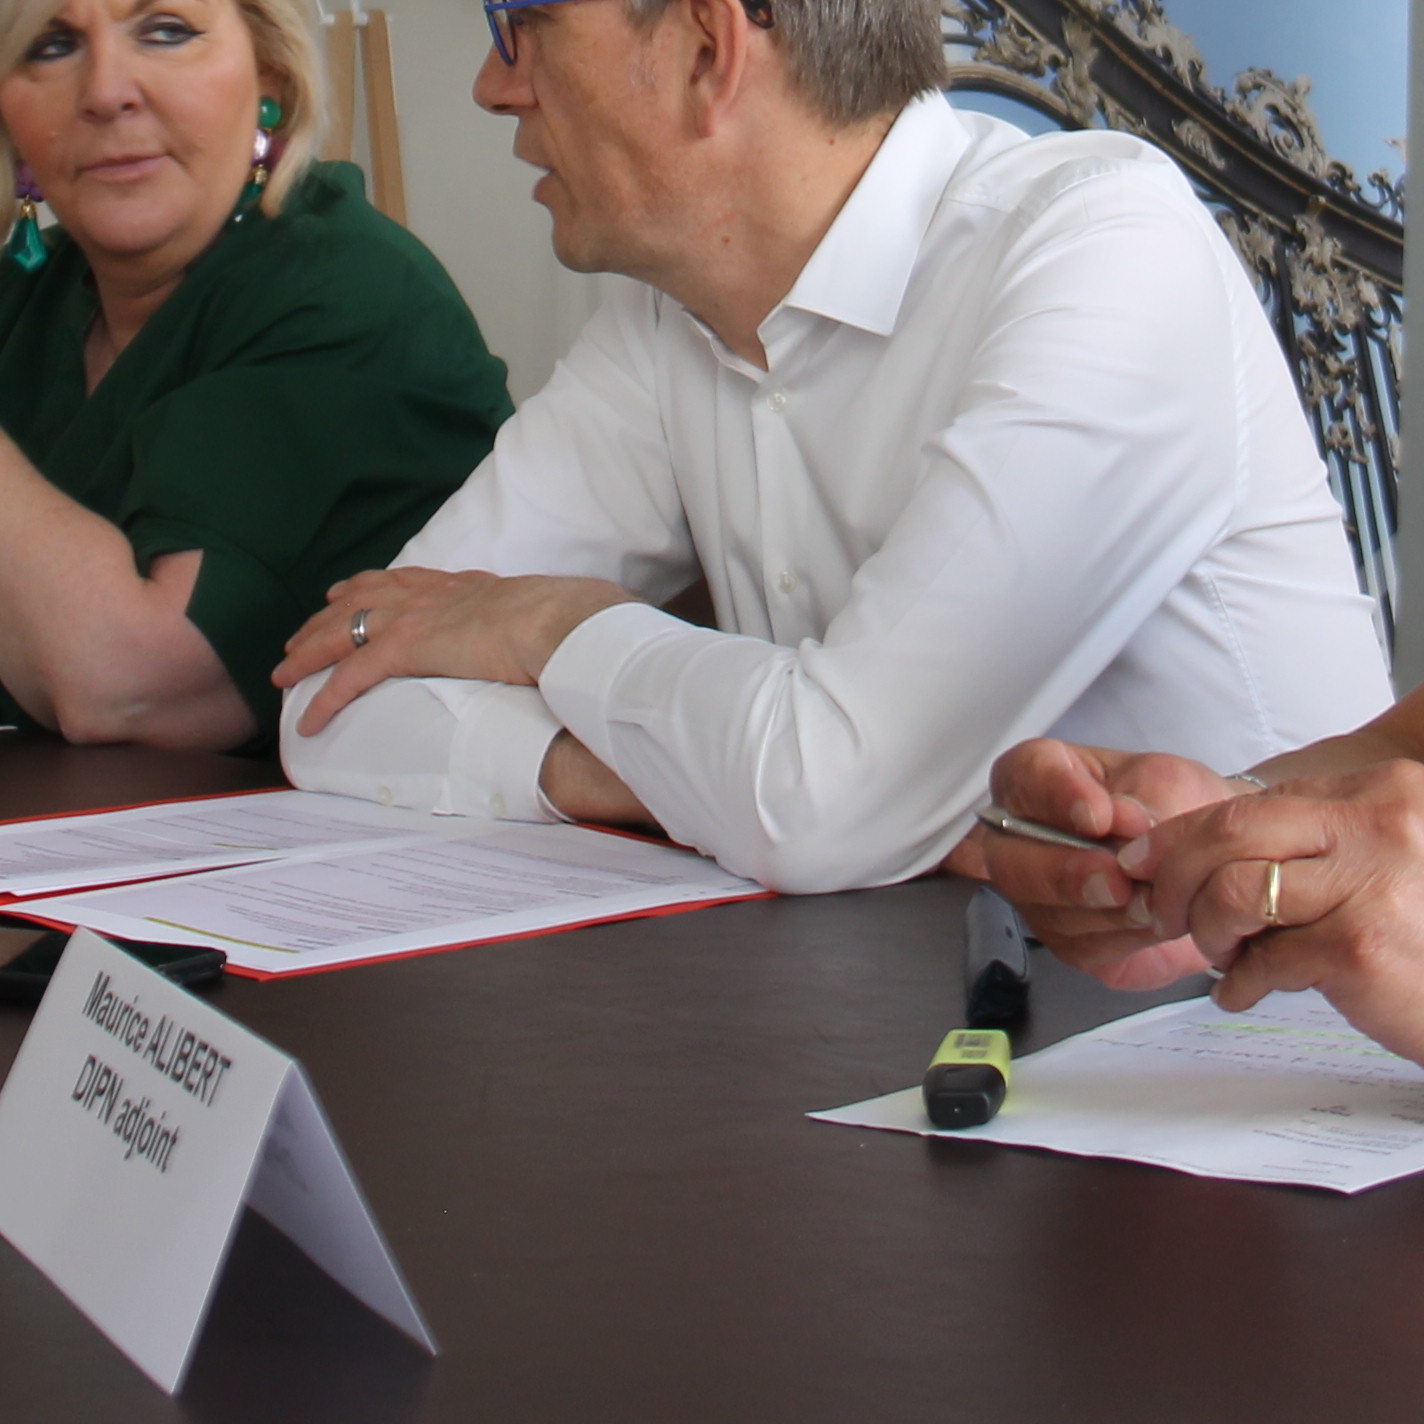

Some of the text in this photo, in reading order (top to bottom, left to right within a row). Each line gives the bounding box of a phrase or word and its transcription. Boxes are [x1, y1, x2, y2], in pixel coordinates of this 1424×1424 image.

[81, 970, 233, 1107] Maurice ALIBERT
[71, 1053, 179, 1173] DIPN adjoint
